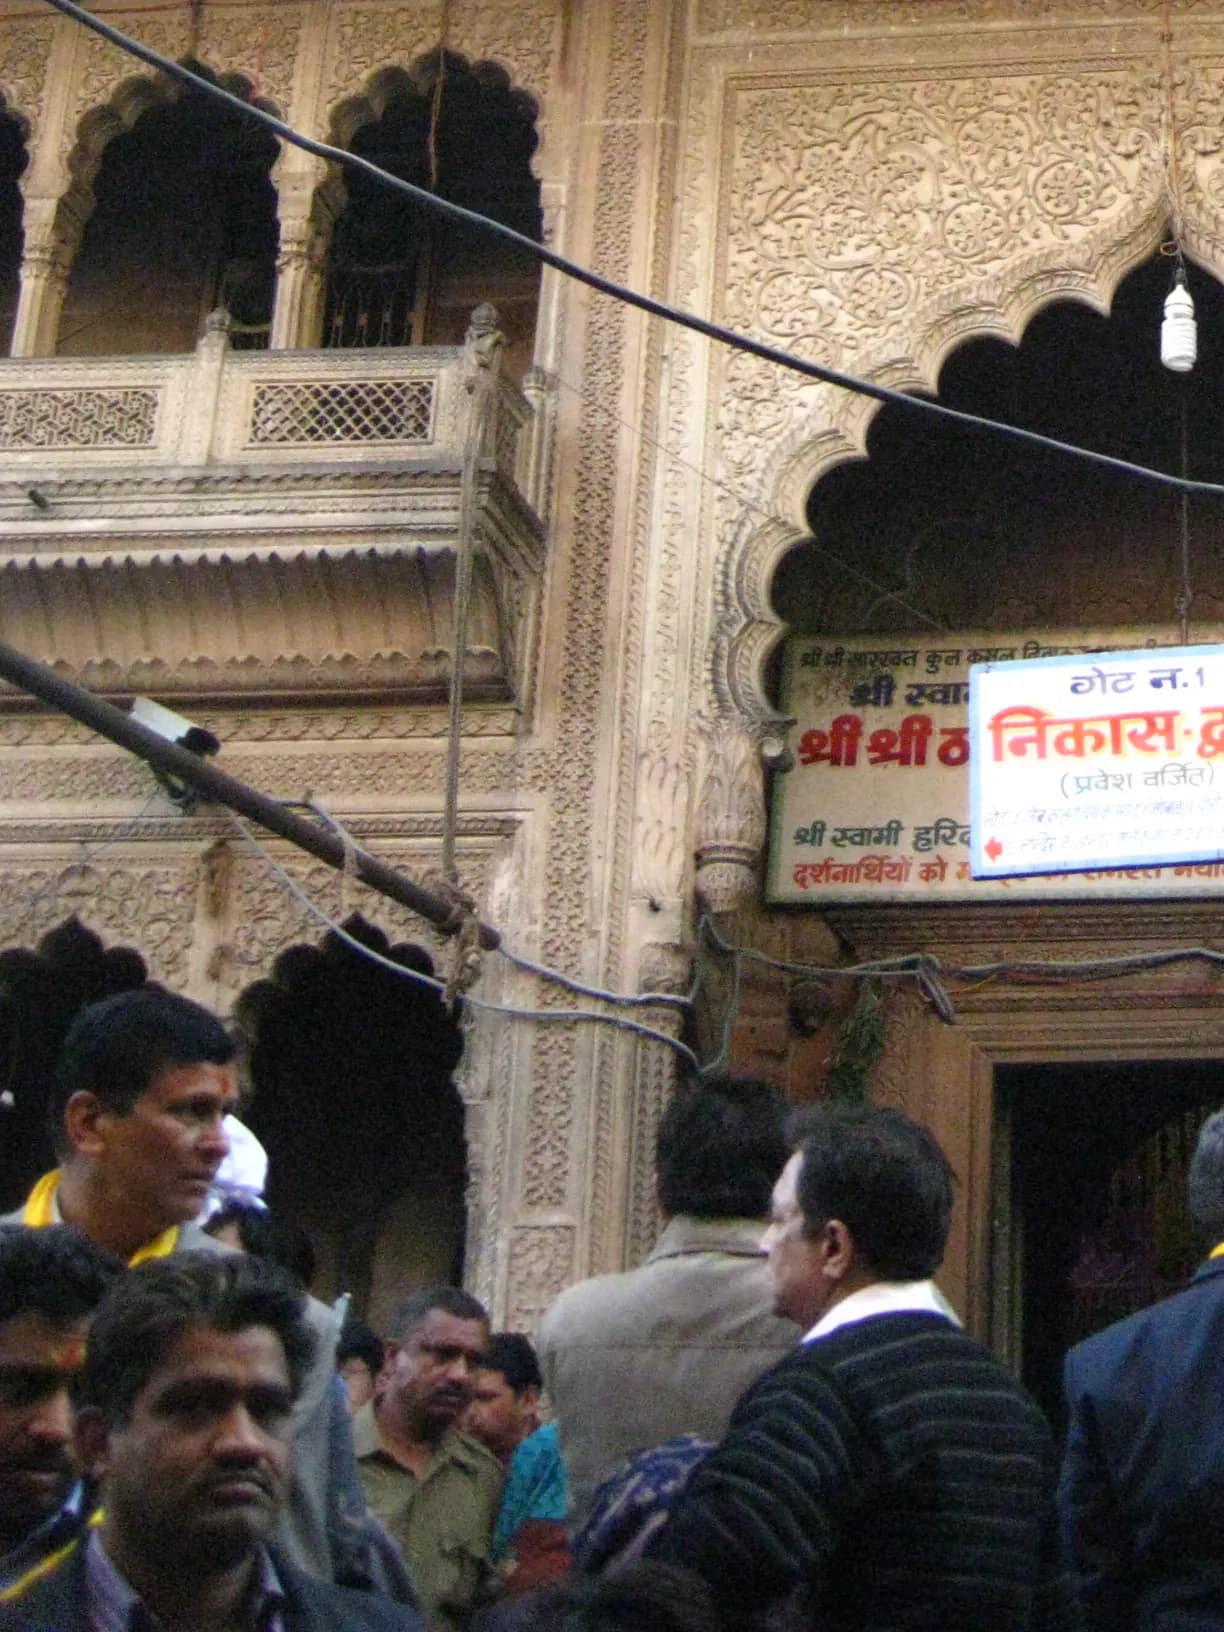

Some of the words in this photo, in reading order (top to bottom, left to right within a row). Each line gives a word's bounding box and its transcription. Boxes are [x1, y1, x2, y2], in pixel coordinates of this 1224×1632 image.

[925, 649, 962, 673] कुल
[1070, 668, 1136, 695] गेट
[798, 714, 864, 767] श्री
[866, 714, 932, 767] श्री
[793, 821, 828, 847] श्री
[831, 819, 904, 848] स्वामी
[912, 818, 971, 852] हरिद
[793, 854, 914, 890] दर्शनार्थियों
[919, 854, 949, 883] को
